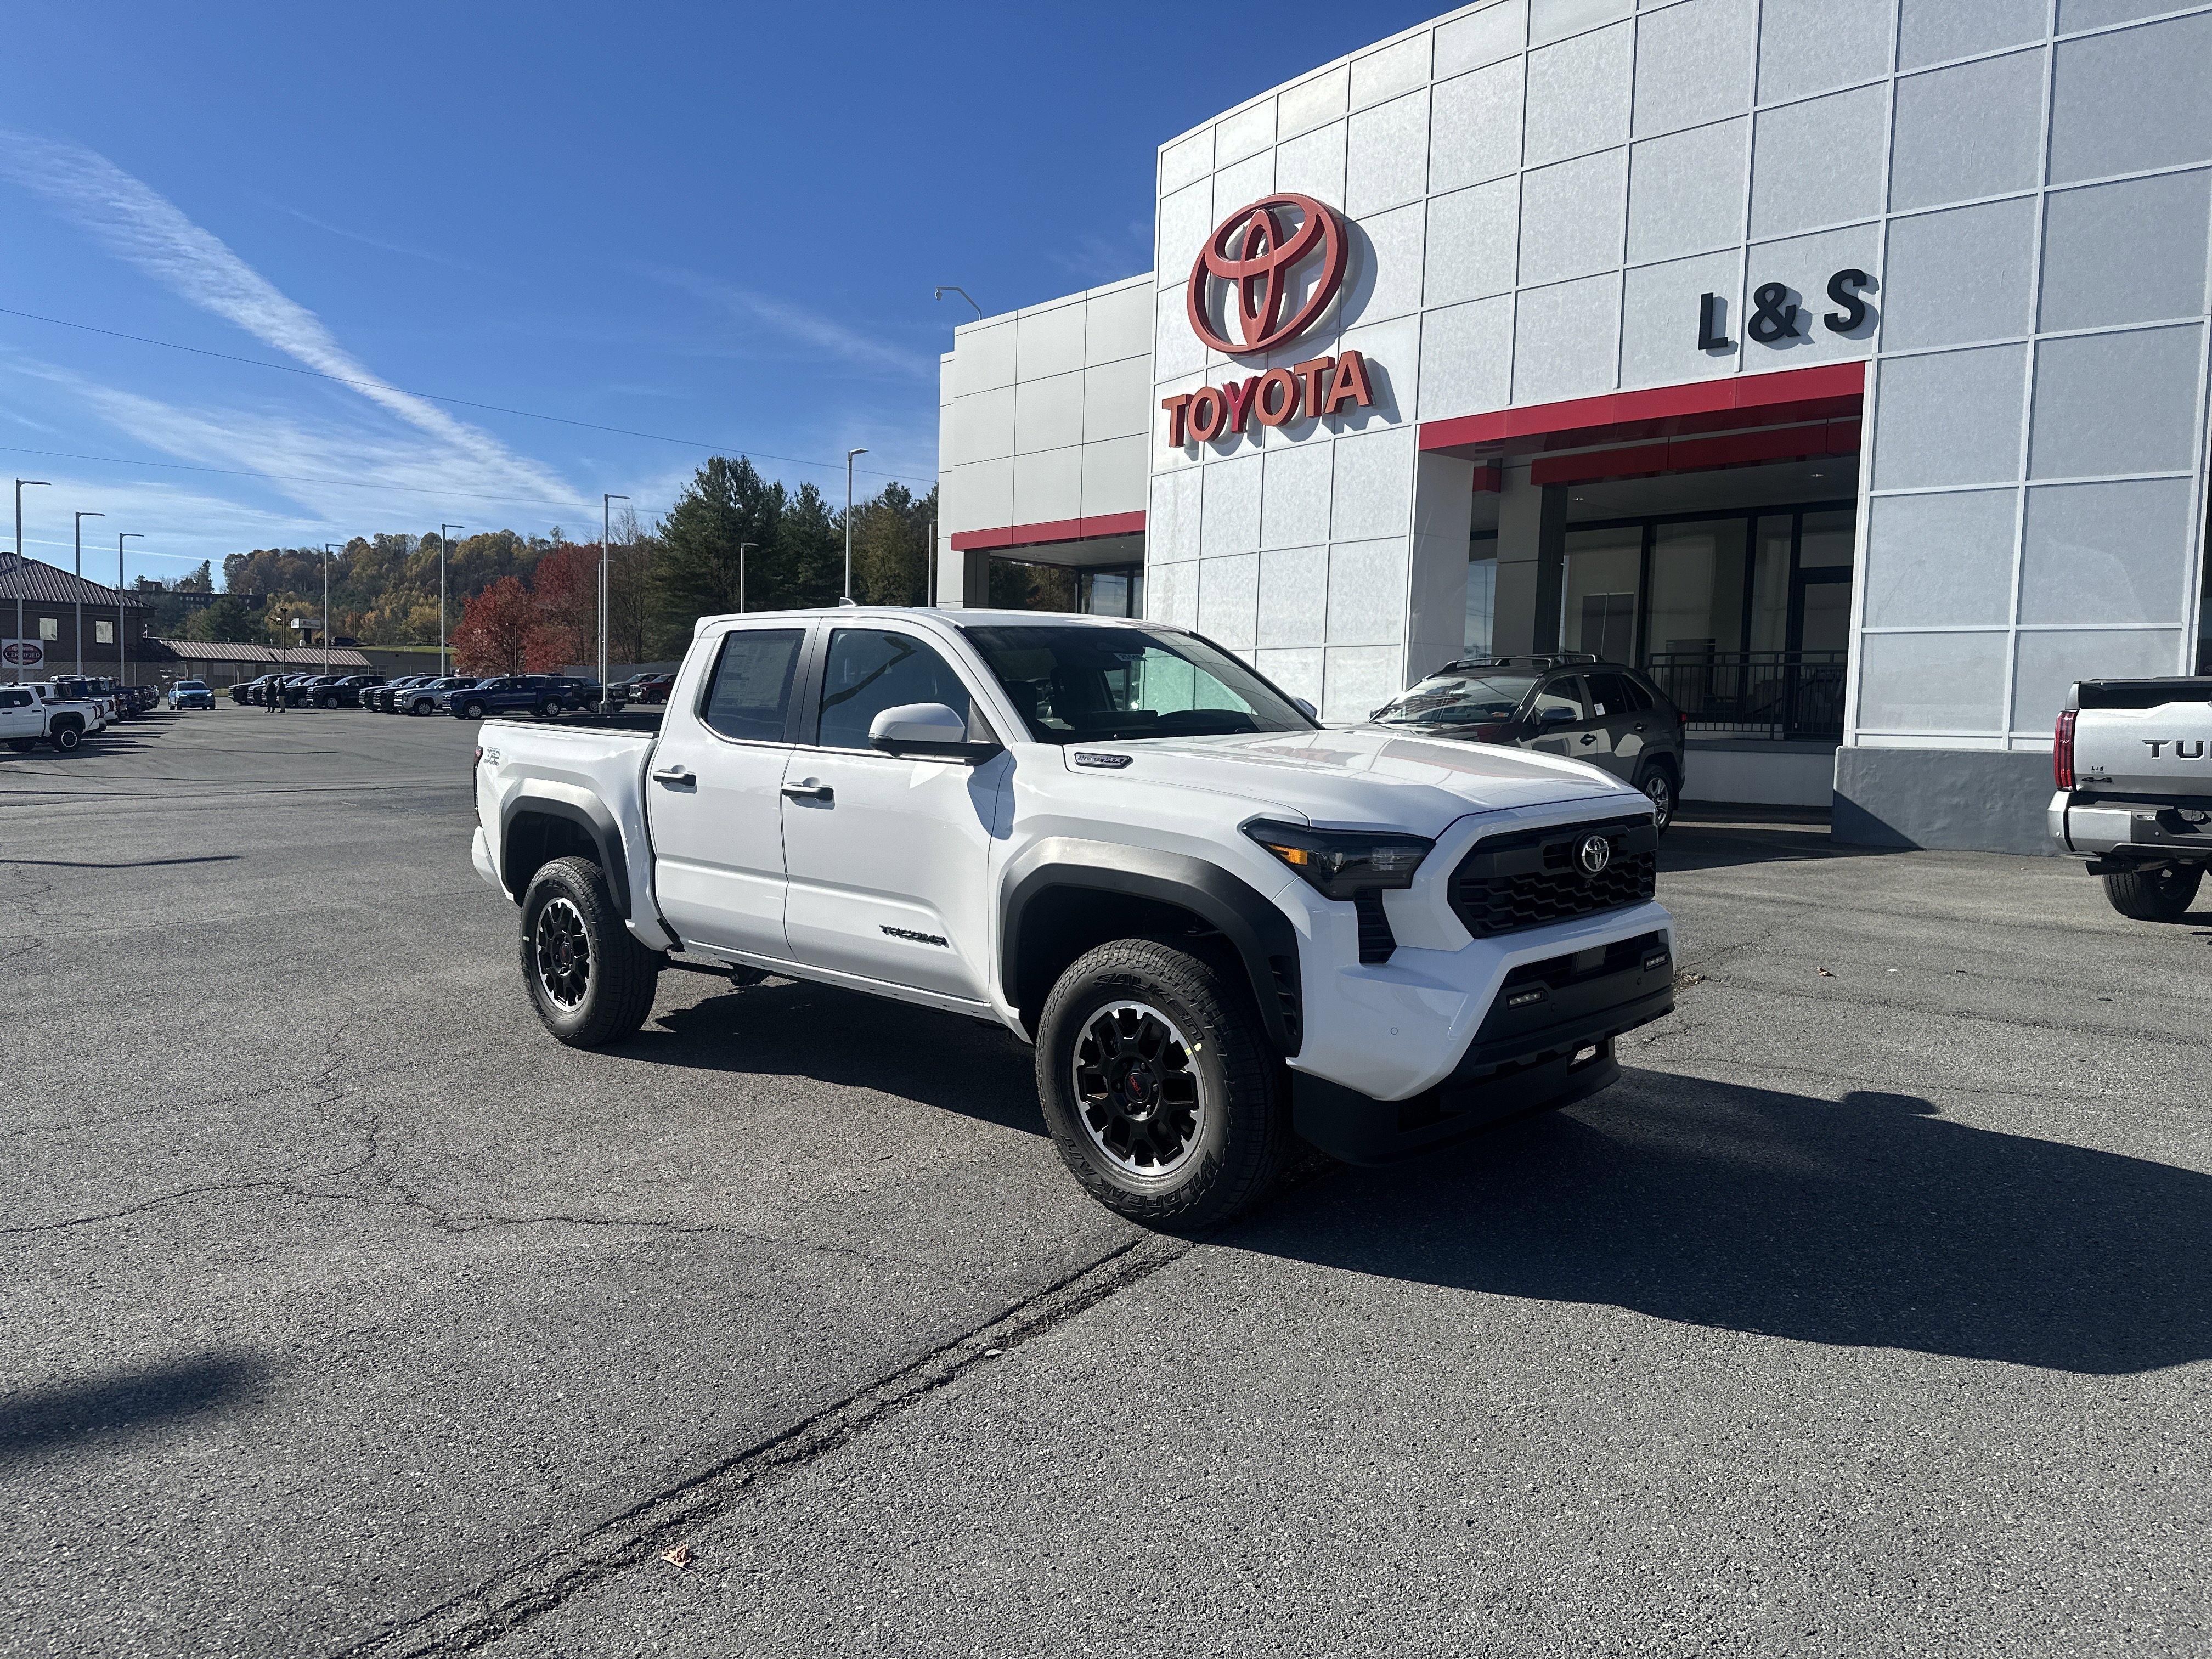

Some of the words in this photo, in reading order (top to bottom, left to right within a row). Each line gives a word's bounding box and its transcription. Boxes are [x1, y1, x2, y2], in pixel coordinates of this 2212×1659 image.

[1699, 292, 1729, 351] L
[1748, 282, 1801, 342] &
[1824, 268, 1867, 332] S
[1162, 350, 1373, 449] TOYOTA
[2141, 740, 2212, 760] TU
[879, 924, 949, 947] TACOMA
[1094, 1150, 1219, 1208] WILDPEAK
